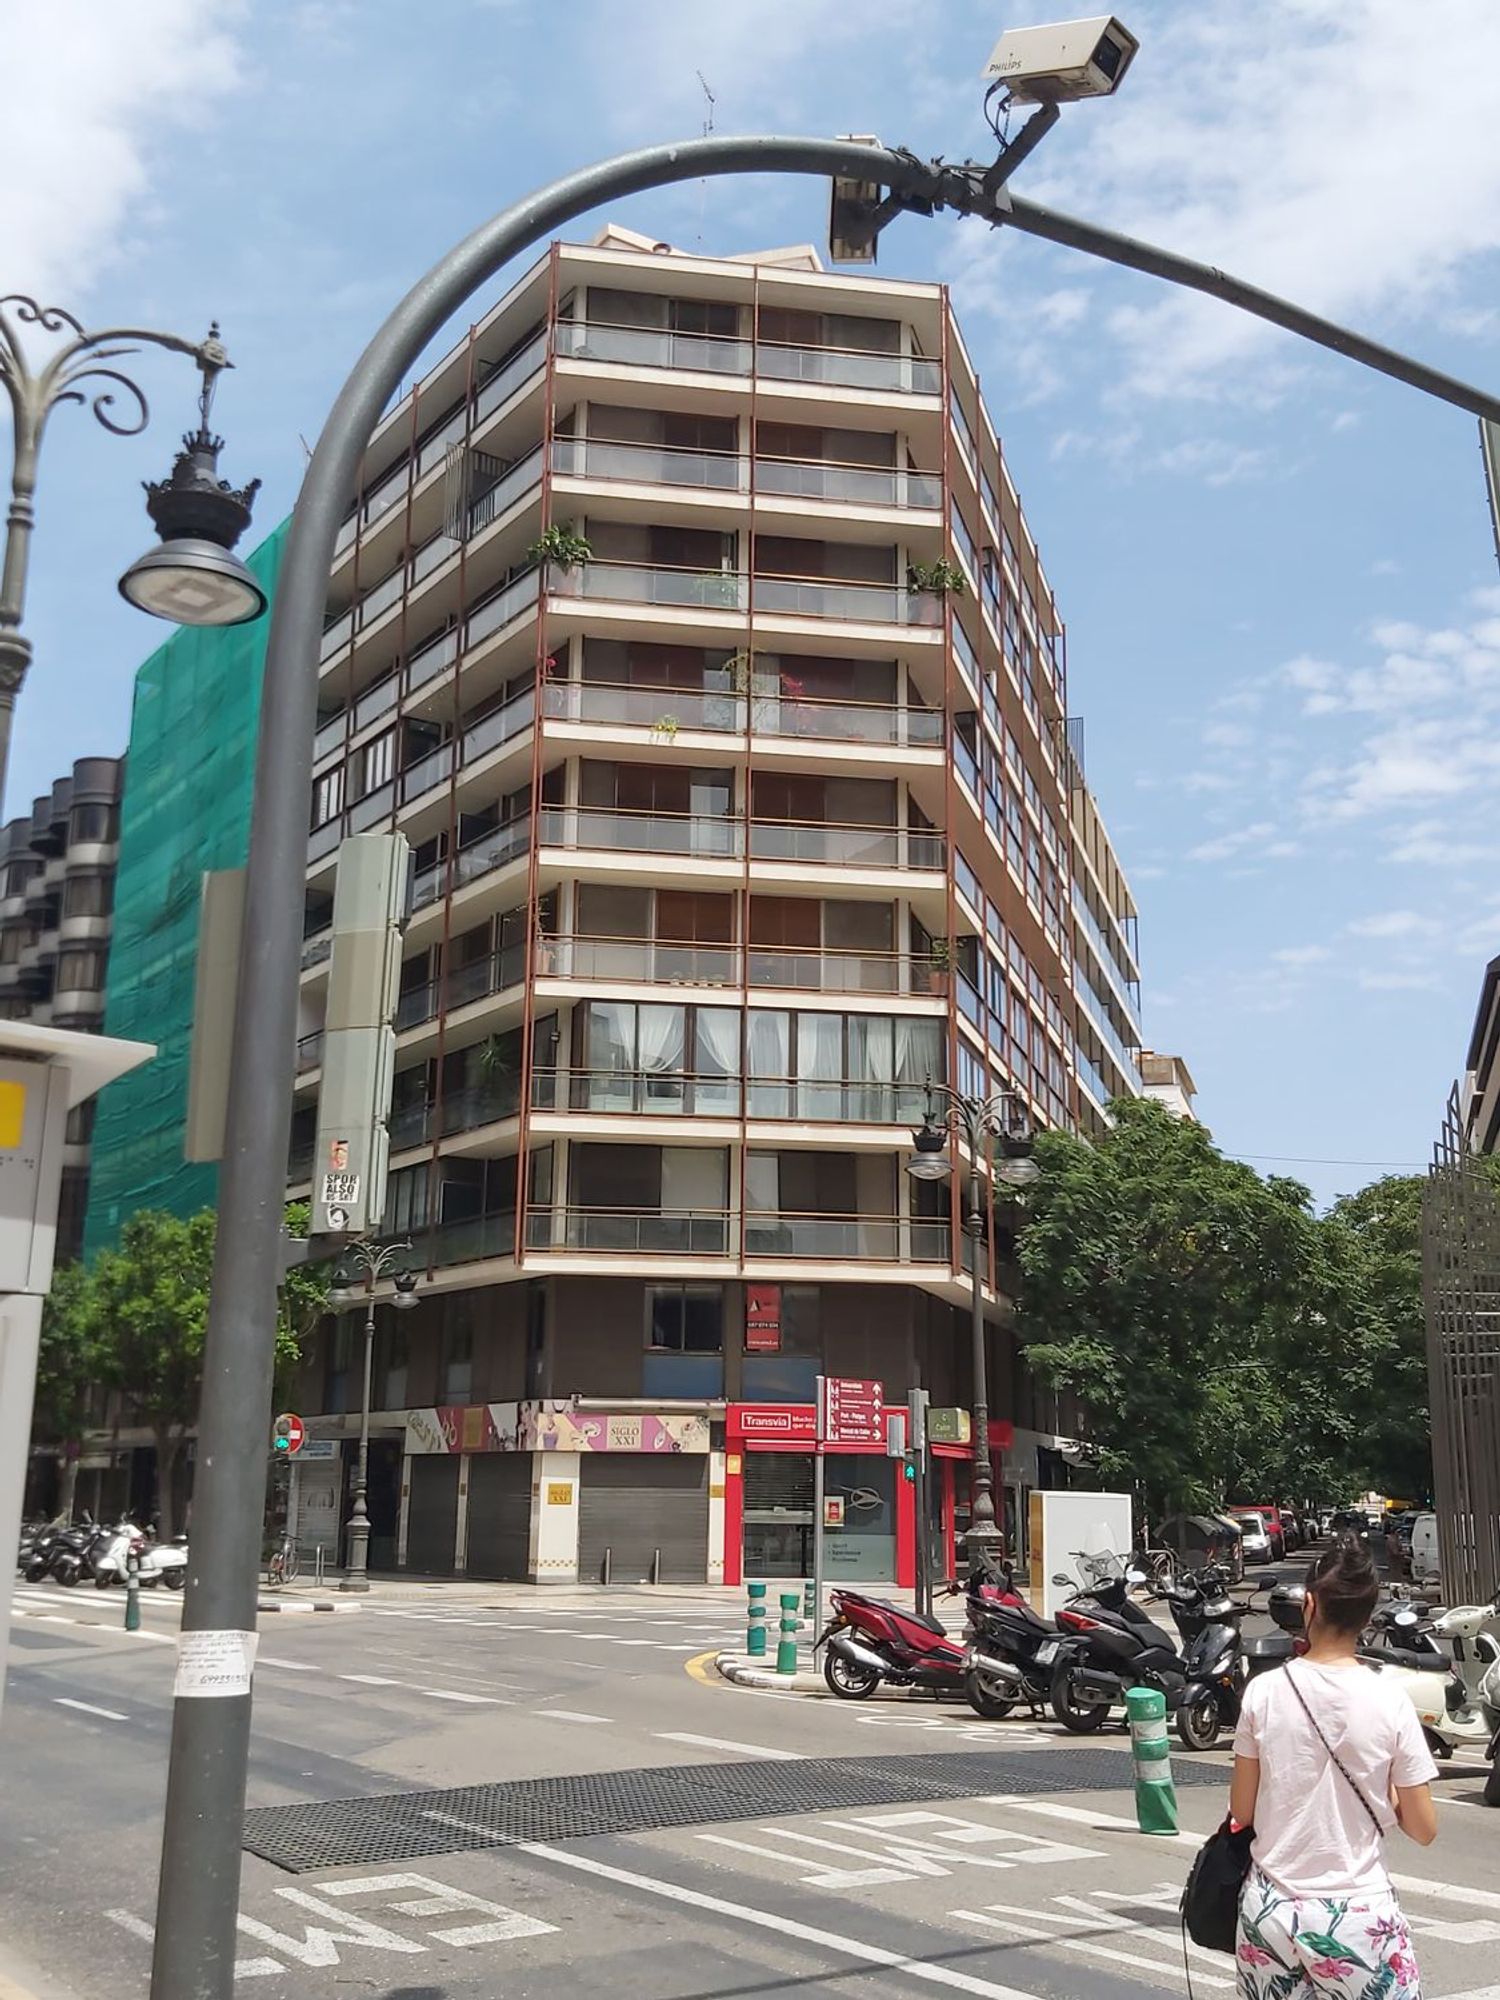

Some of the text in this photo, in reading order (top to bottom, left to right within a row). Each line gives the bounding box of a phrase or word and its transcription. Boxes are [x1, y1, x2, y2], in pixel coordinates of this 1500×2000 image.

[989, 61, 1022, 72] PHILIPS
[745, 1416, 787, 1427] Transvia
[611, 1427, 640, 1436] SIGLO
[615, 1436, 635, 1446] XXI
